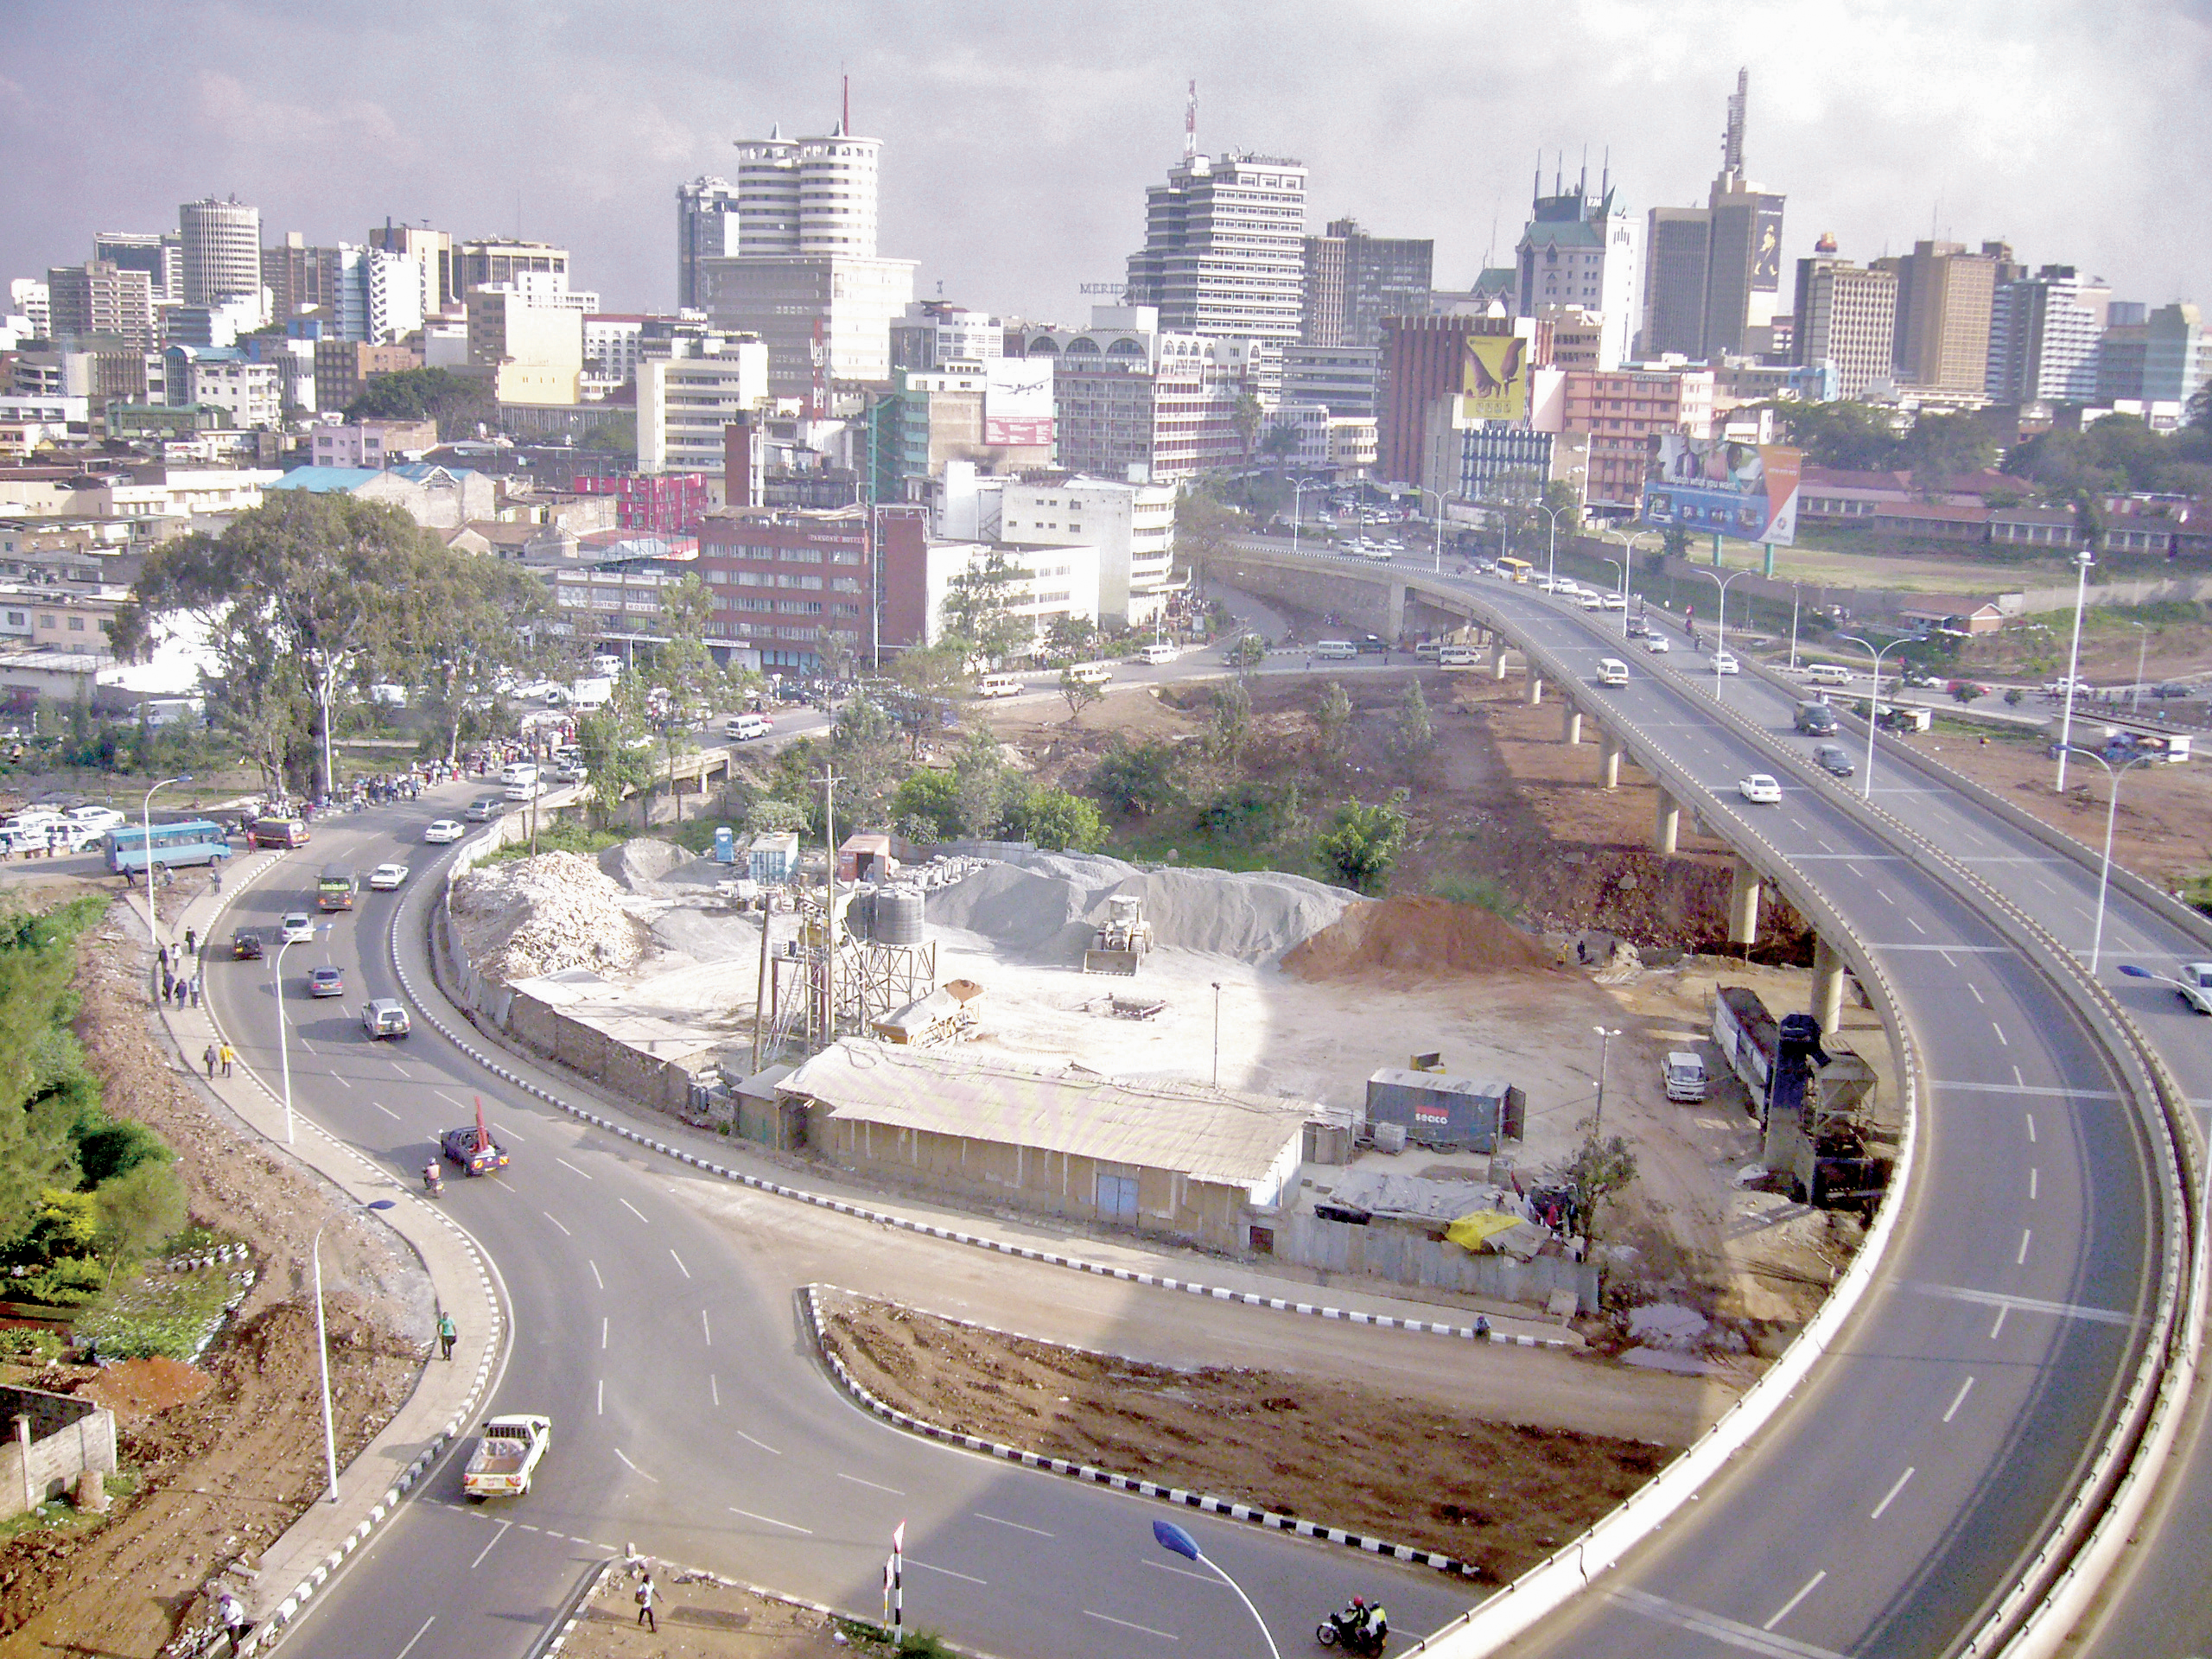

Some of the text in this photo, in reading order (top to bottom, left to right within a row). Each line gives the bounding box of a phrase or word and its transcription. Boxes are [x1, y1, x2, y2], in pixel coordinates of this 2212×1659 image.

[1690, 476, 1706, 486] what
[1707, 480, 1718, 489] you
[1415, 1113, 1448, 1125] seaco
